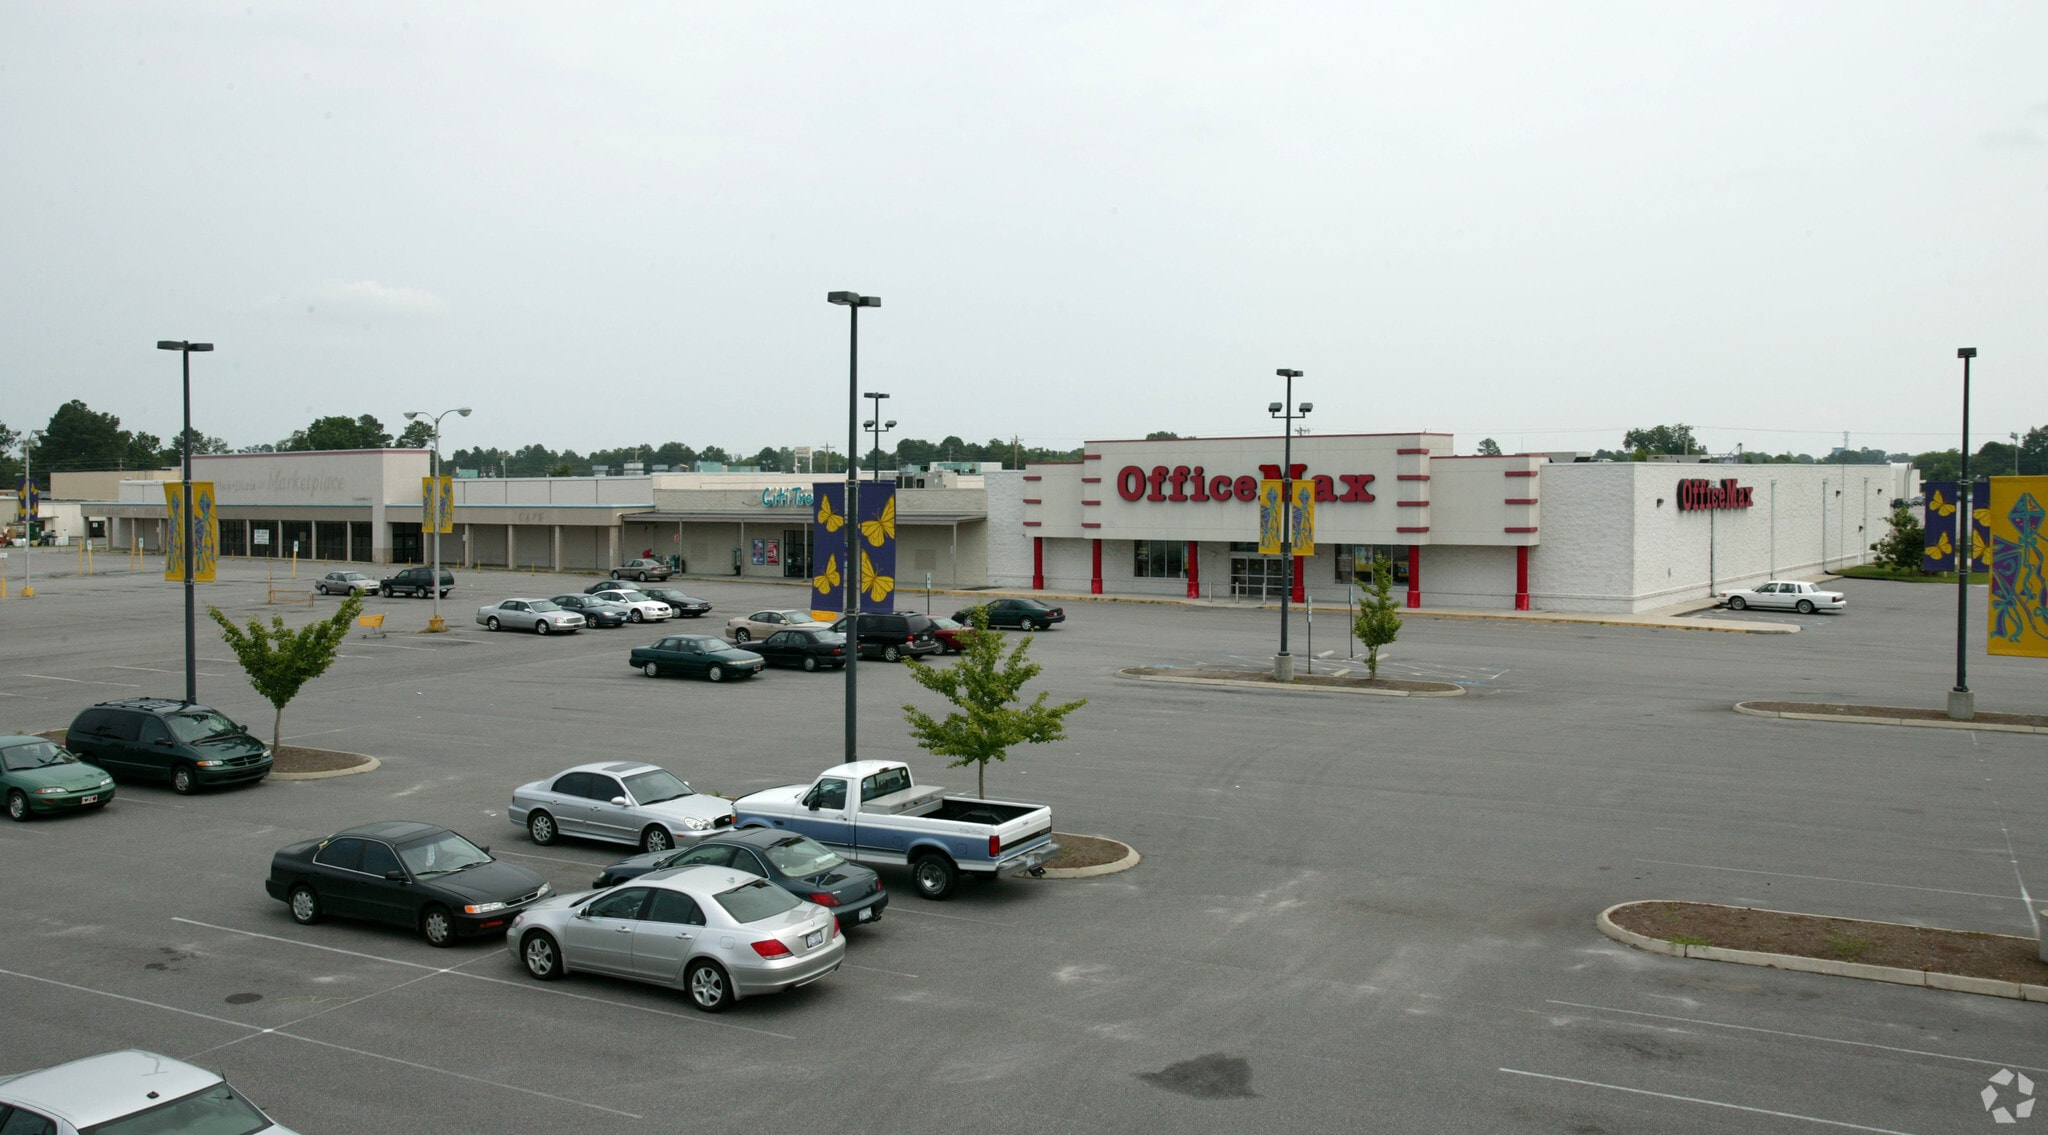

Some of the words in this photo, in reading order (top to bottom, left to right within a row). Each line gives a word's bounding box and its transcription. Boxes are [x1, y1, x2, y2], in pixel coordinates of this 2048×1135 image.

[267, 468, 344, 497] Marketplace
[762, 487, 790, 506] Citi
[792, 487, 814, 506] Tre
[1680, 479, 1753, 511] OfficeMax
